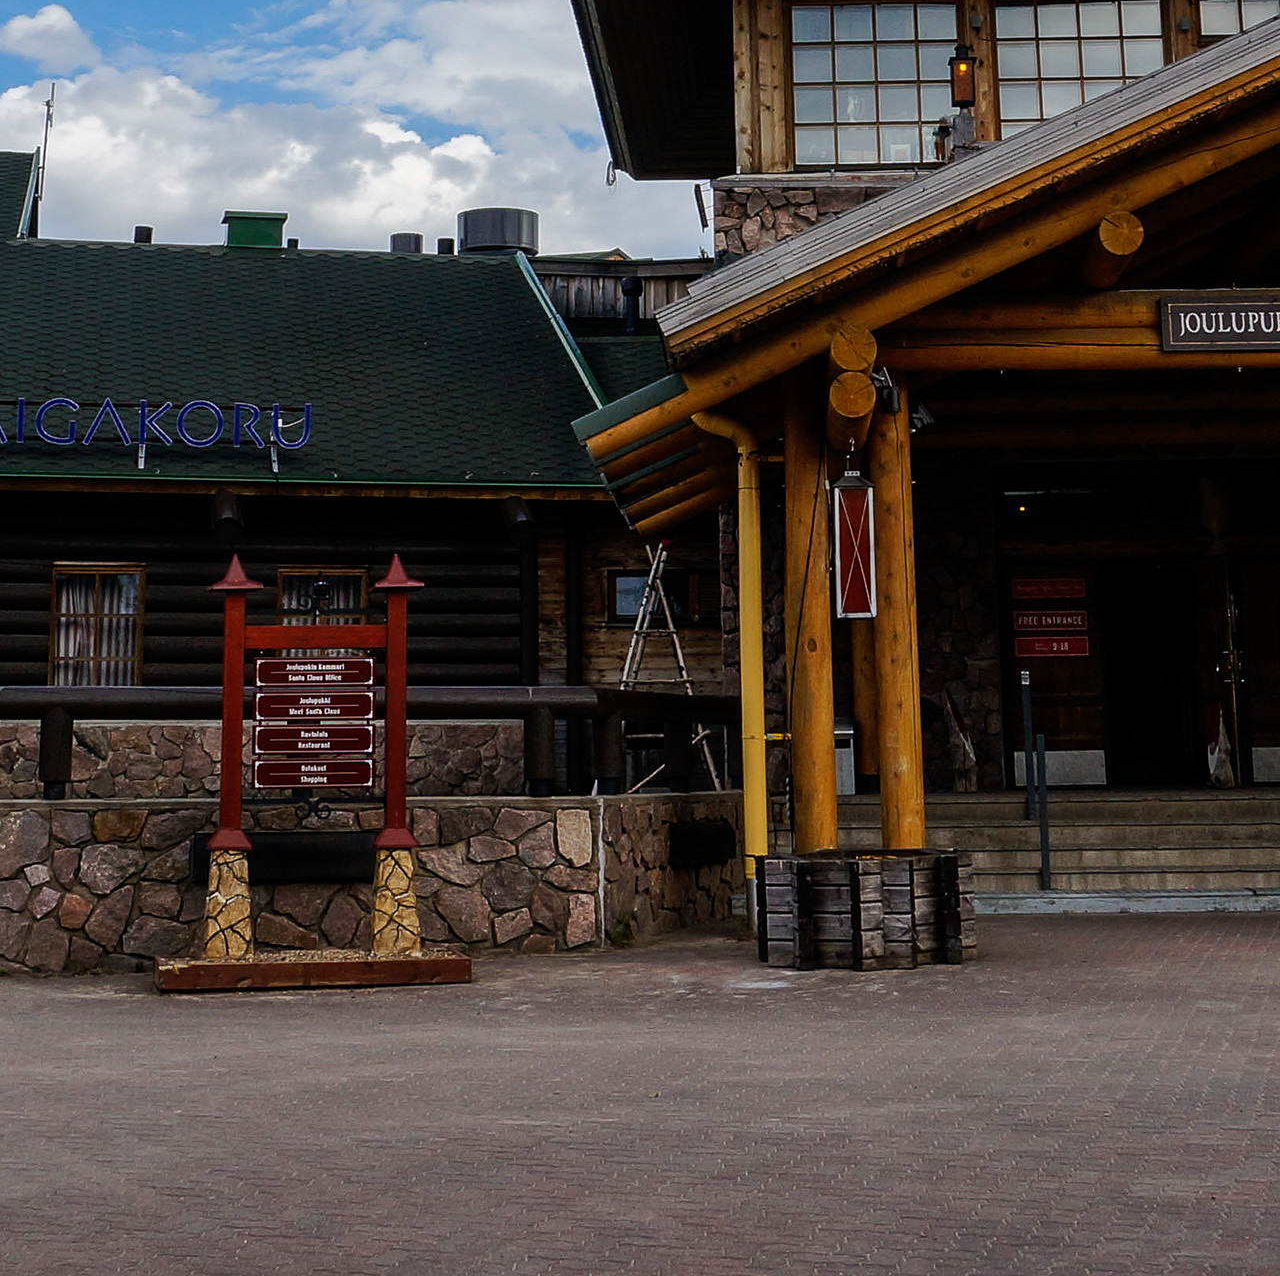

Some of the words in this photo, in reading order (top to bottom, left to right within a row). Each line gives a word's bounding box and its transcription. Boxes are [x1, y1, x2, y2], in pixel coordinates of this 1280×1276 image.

[1018, 616, 1039, 625] FREE
[1042, 615, 1083, 625] ENTRANCE
[300, 776, 328, 784] Shopping
